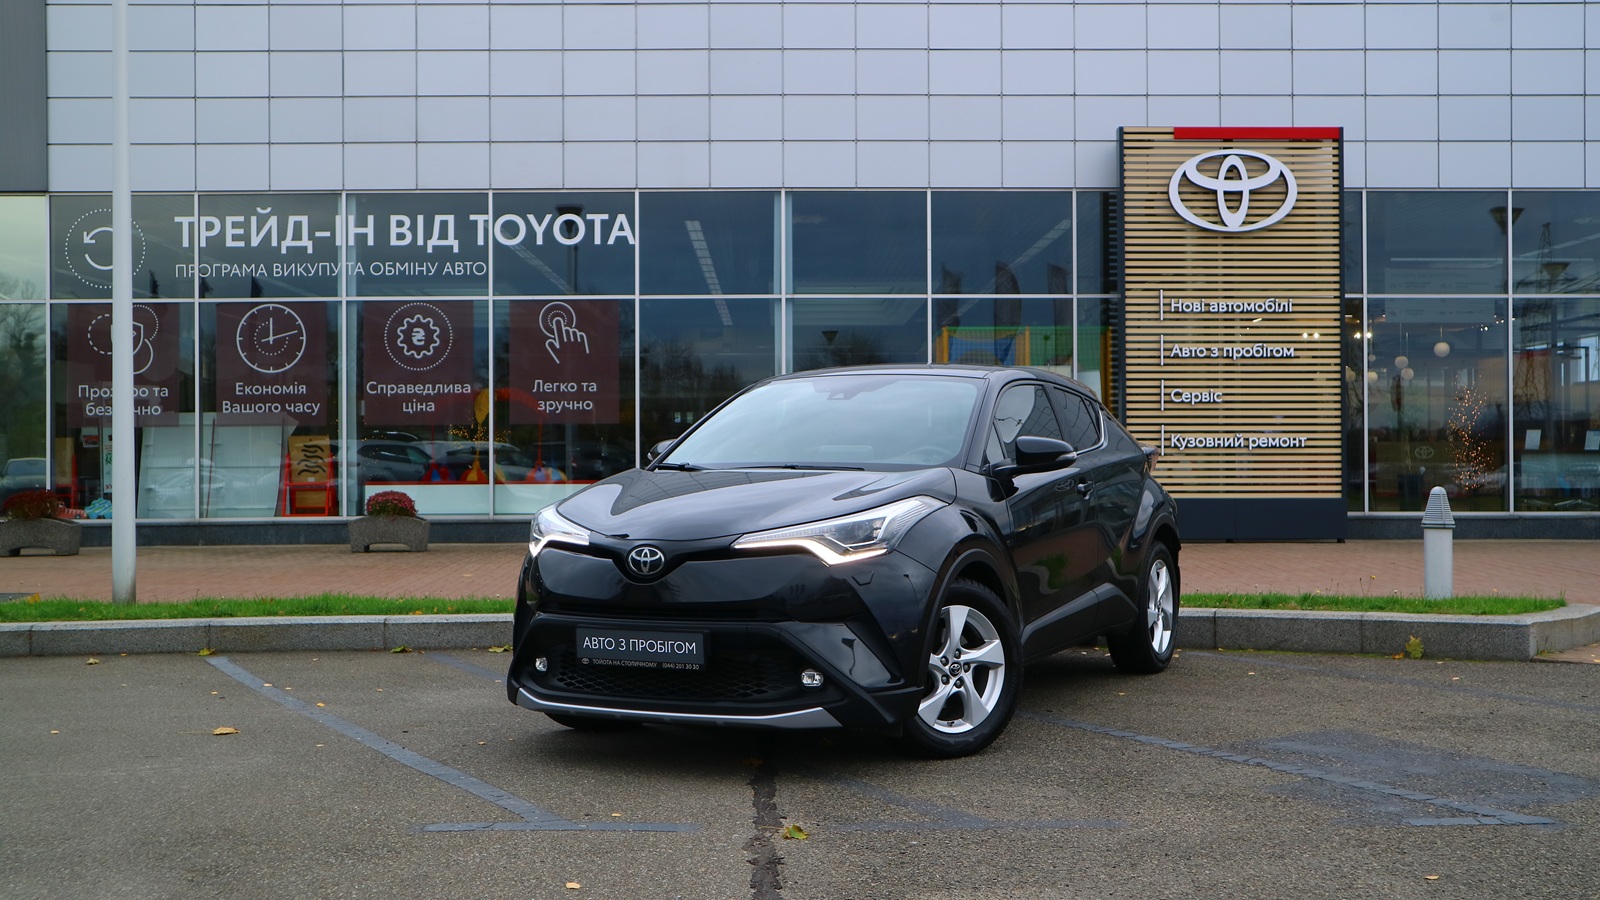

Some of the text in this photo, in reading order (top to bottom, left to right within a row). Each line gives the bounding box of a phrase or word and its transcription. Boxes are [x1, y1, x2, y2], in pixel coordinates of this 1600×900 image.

[174, 206, 636, 254] ТРЕЙД-ІН ВІД TOYOTA
[175, 261, 487, 278] ПРОГРАМА ВИКУПУ ТА ОБМІНУ АВТО
[1170, 298, 1293, 312] Нові автомобілі
[1170, 344, 1295, 360] Авто з пробігом
[152, 387, 169, 397] та
[235, 382, 306, 395] Економія
[366, 381, 472, 396] Справедлива
[532, 380, 597, 393] Легко та
[1170, 389, 1223, 406] Сервіс
[222, 401, 321, 416] Вашого часу
[402, 398, 436, 414] ціна
[537, 399, 594, 414] зручно
[1170, 433, 1307, 450] Кузовний ремонт
[583, 636, 615, 650] АВТО
[629, 639, 696, 654] ПРОБІГОМ
